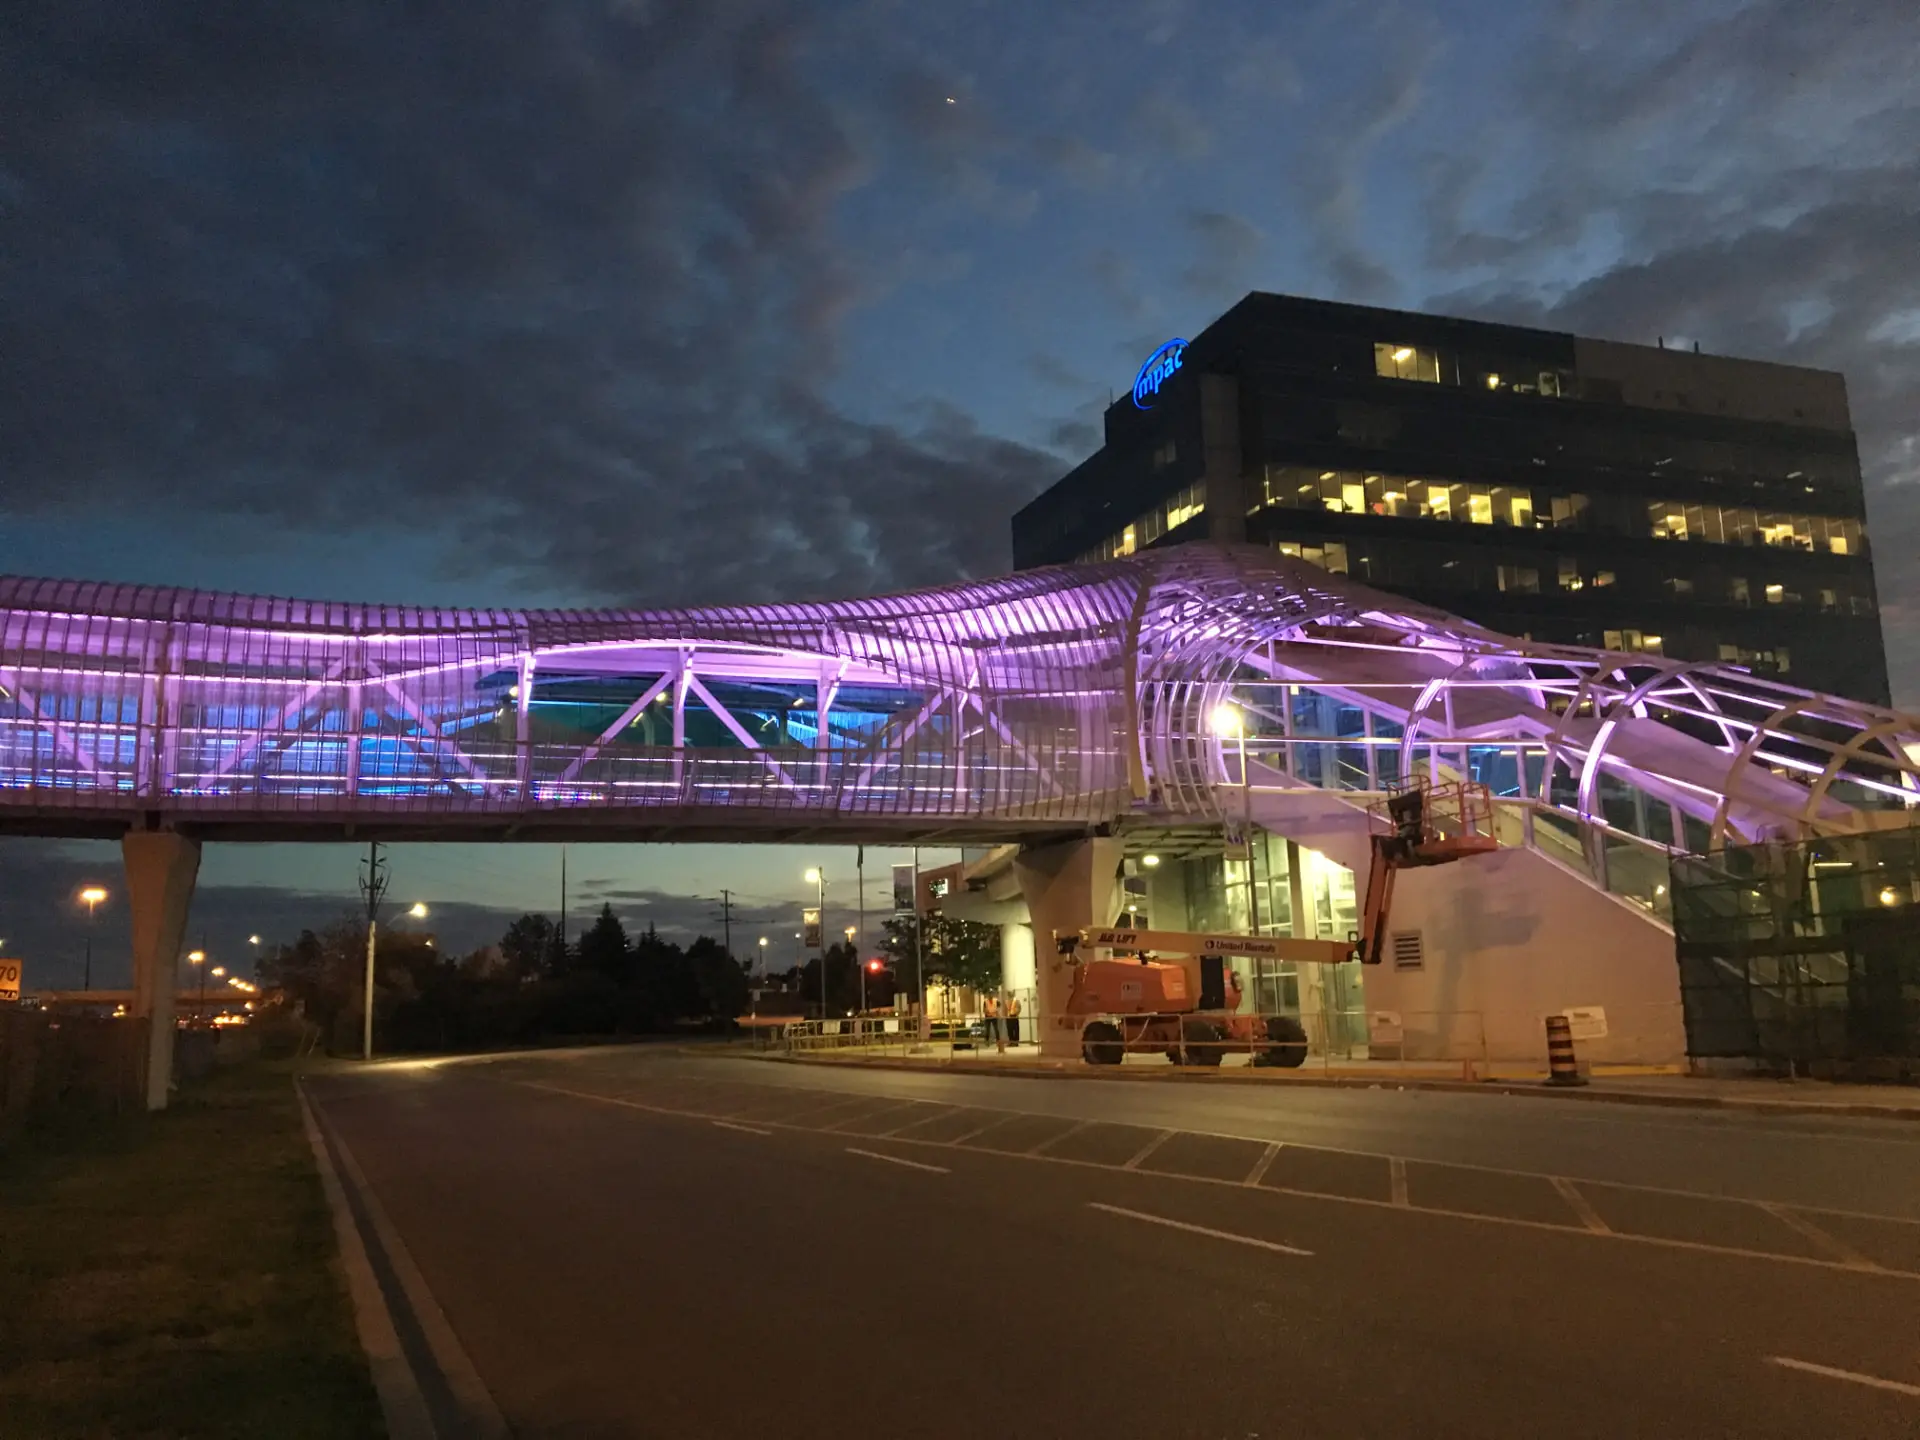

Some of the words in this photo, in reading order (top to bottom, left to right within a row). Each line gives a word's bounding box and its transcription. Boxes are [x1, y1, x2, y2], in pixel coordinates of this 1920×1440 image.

[1138, 347, 1183, 399] mpac
[1216, 940, 1243, 951] United
[0, 966, 17, 982] 70
